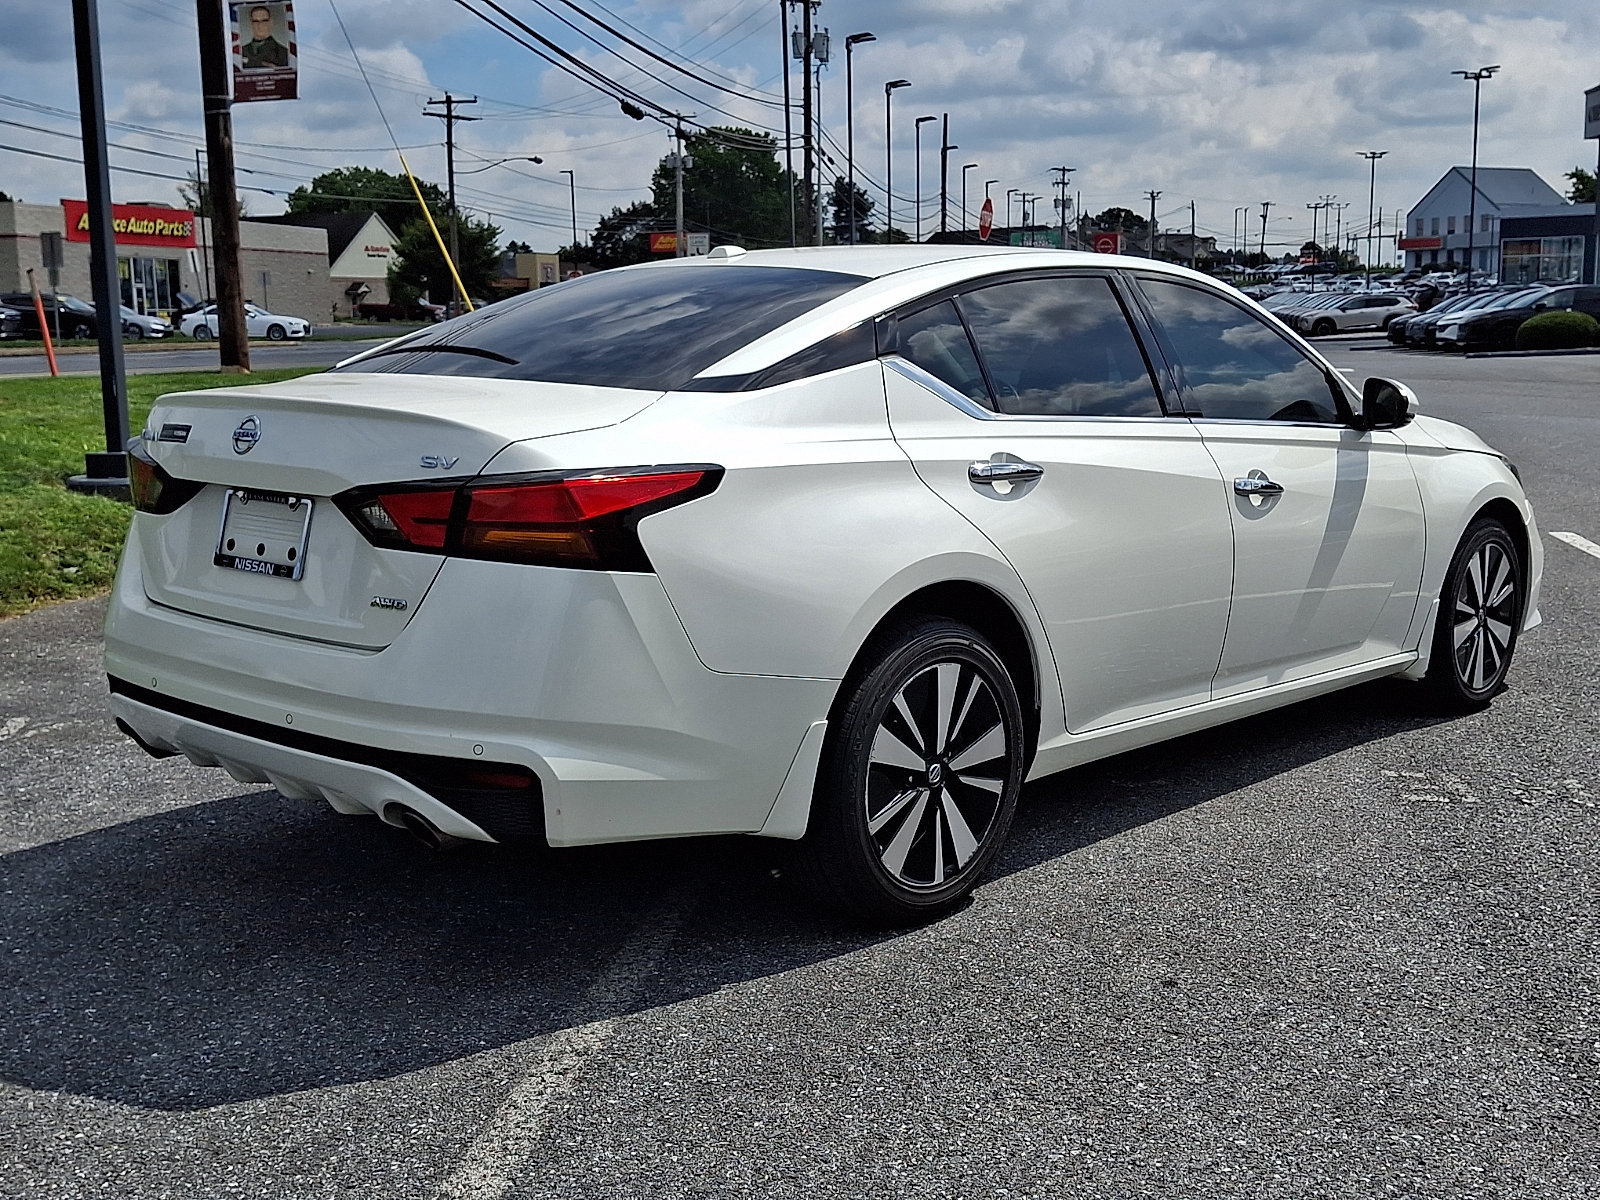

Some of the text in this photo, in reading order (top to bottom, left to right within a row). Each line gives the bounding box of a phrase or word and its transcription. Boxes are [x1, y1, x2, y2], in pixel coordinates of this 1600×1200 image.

[127, 217, 154, 234] Auto
[155, 218, 184, 236] Parts
[420, 455, 460, 470] SV
[234, 557, 275, 575] NISSAN
[370, 595, 408, 611] AWD
